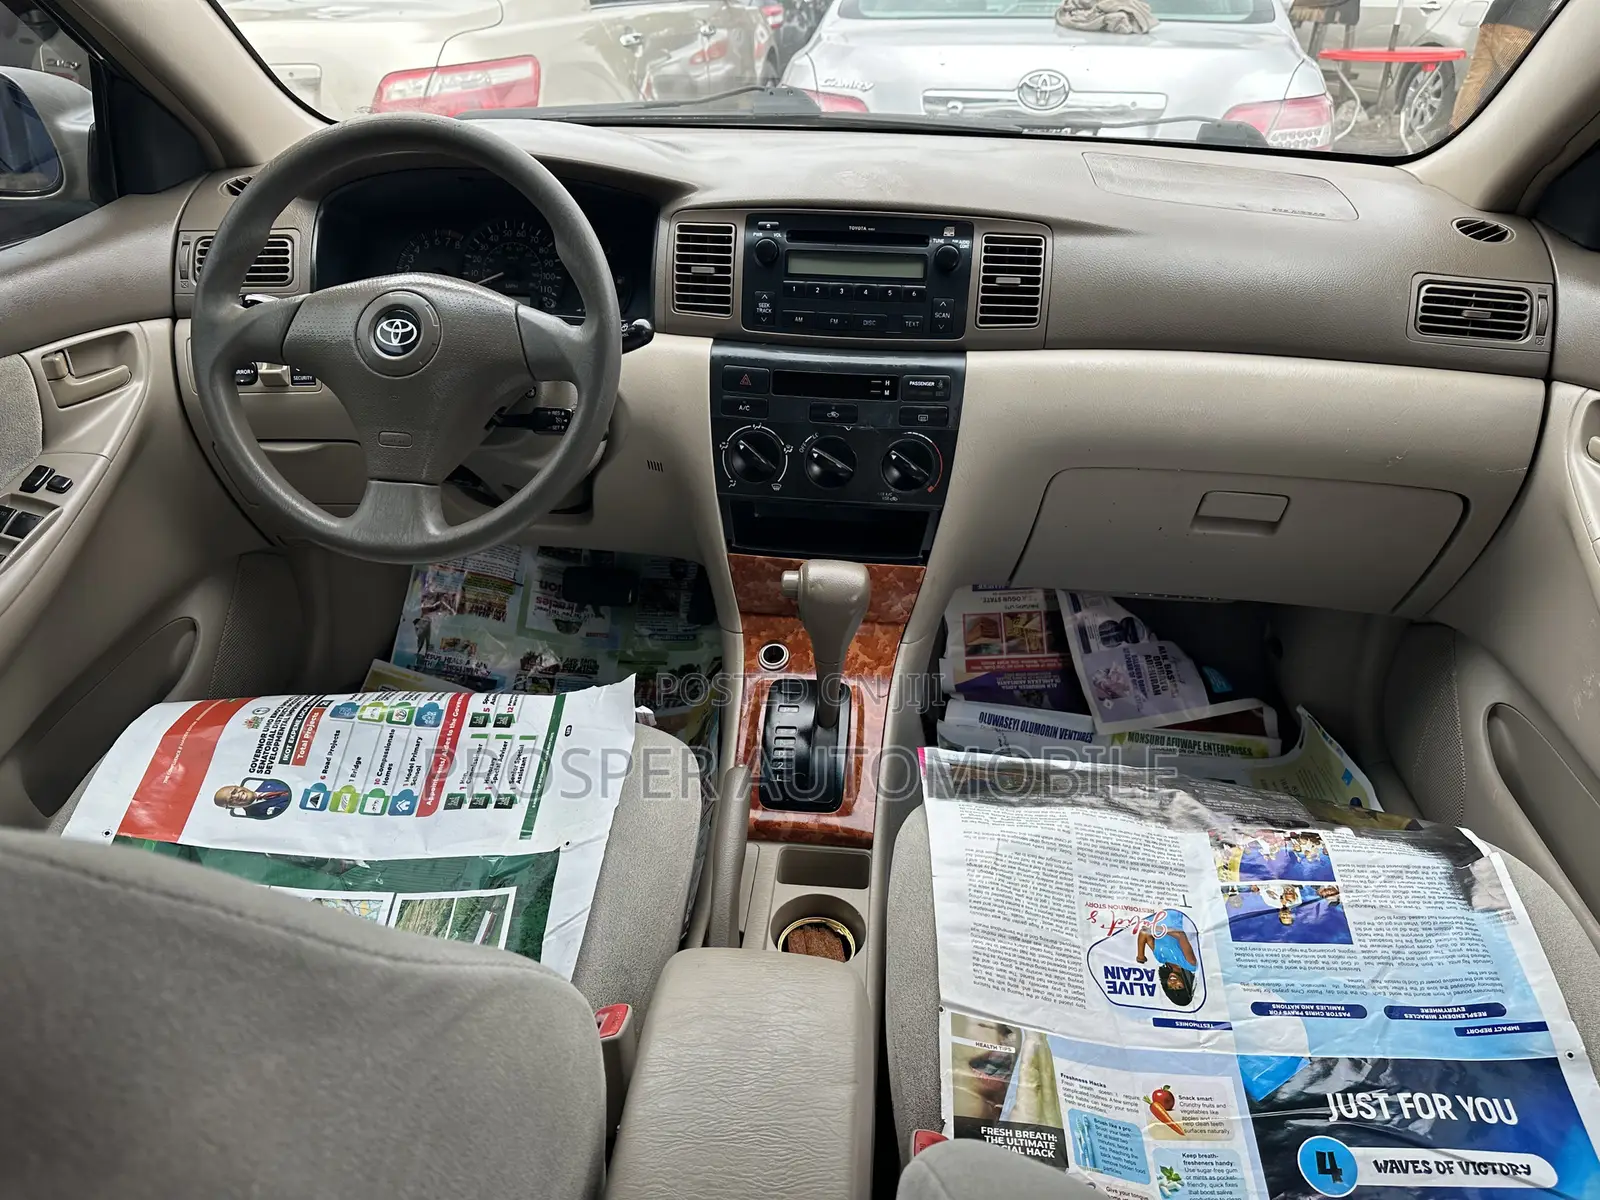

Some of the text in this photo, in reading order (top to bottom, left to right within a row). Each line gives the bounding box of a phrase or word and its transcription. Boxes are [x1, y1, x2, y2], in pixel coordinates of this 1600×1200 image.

[507, 704, 514, 713] 12
[449, 717, 457, 729] the
[978, 711, 1094, 744] OLUWASEYI OLUMORIN VENTURES
[297, 740, 309, 760] Total
[304, 712, 319, 739] Projects
[447, 729, 454, 738] to
[249, 732, 268, 774] GOVERNOR
[256, 727, 277, 774] SENATORIAL
[264, 717, 291, 775] DEVELOPMENTAL
[282, 745, 292, 761] IKOT
[322, 757, 331, 774] Road
[327, 729, 341, 756] Projects
[376, 728, 396, 777] Compassionate
[410, 736, 423, 762] Primary
[441, 739, 451, 757] Aides
[1127, 731, 1166, 746] MONSURU
[1166, 736, 1202, 751] AFUWAPE
[1202, 741, 1253, 757] ENTERPRISES
[350, 756, 362, 779] Bridge
[466, 743, 483, 785] Commissioner
[484, 757, 498, 785] Honorary
[491, 740, 509, 785] Special Adviser
[509, 765, 518, 785] Senior
[515, 744, 525, 766] Special
[515, 756, 528, 785] Assistant
[777, 761, 784, 769] 2
[382, 763, 394, 786] Homes
[410, 765, 422, 787] School
[1084, 901, 1155, 914] RESTORATION STORY
[1103, 965, 1156, 981] AGAIN
[1105, 980, 1156, 997] ALIVE
[1325, 1010, 1351, 1018] PASTOR
[1438, 1011, 1487, 1019] RESPLENDENT
[1175, 1021, 1215, 1029] TESTIMONIES
[975, 1041, 998, 1050] HEALTH
[1060, 1072, 1107, 1089] Freshness Hacks
[1061, 1079, 1075, 1087] Fresh
[1325, 1091, 1519, 1126] JUST FOR YOU
[981, 1126, 1058, 1142] FRESH BREATH:
[984, 1135, 1056, 1150] THE ULTIMATE
[1026, 1147, 1055, 1159] HACK
[1315, 1150, 1532, 1184] 4 WAVES OF VICTORY
[1105, 1186, 1118, 1194] Give
